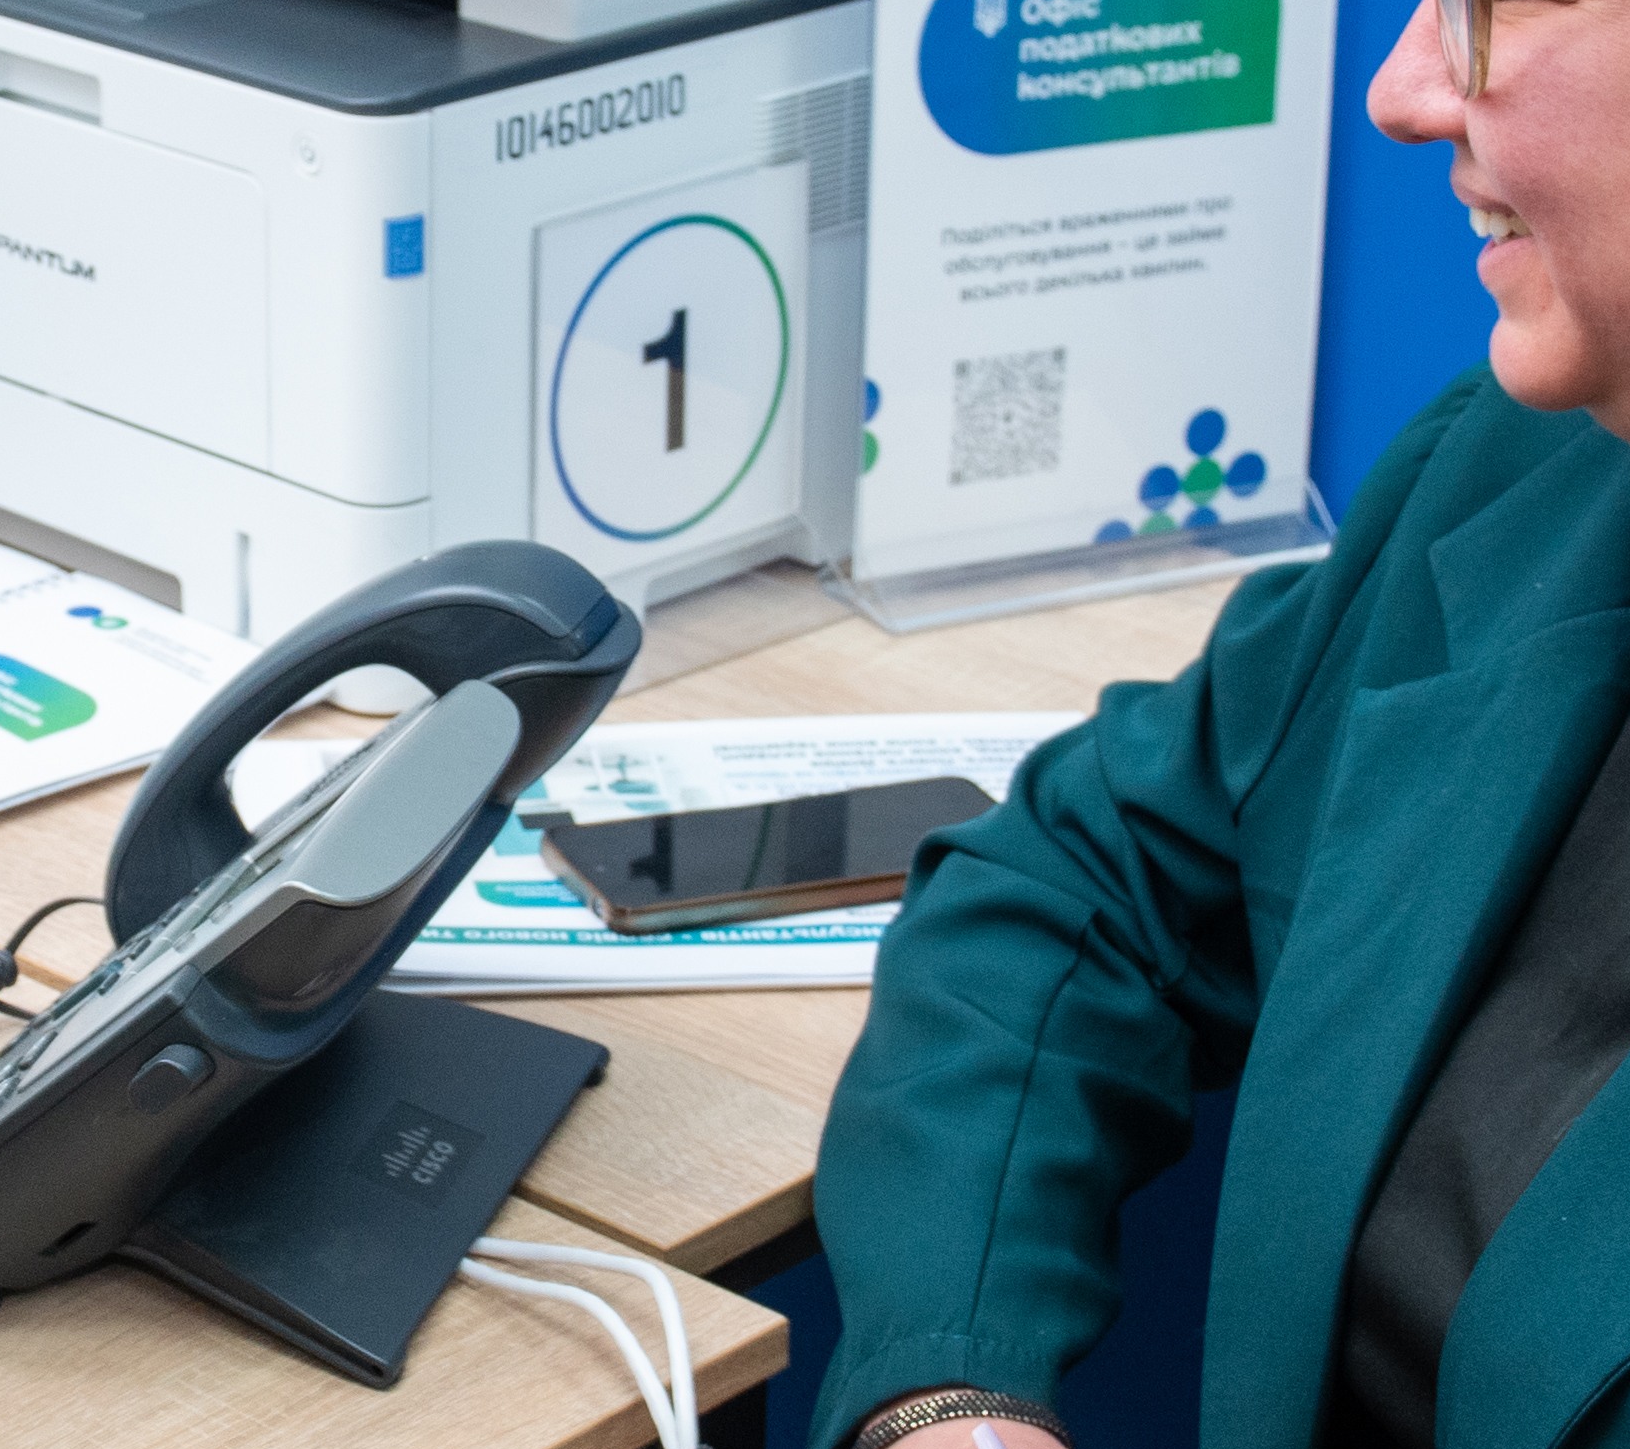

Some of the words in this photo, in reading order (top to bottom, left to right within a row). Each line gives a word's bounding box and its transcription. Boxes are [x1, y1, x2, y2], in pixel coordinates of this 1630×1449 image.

[1018, 49, 1239, 99] консультантів
[1019, 21, 1202, 62] податкових
[496, 73, 685, 162] 10146002010
[644, 308, 687, 452] 1
